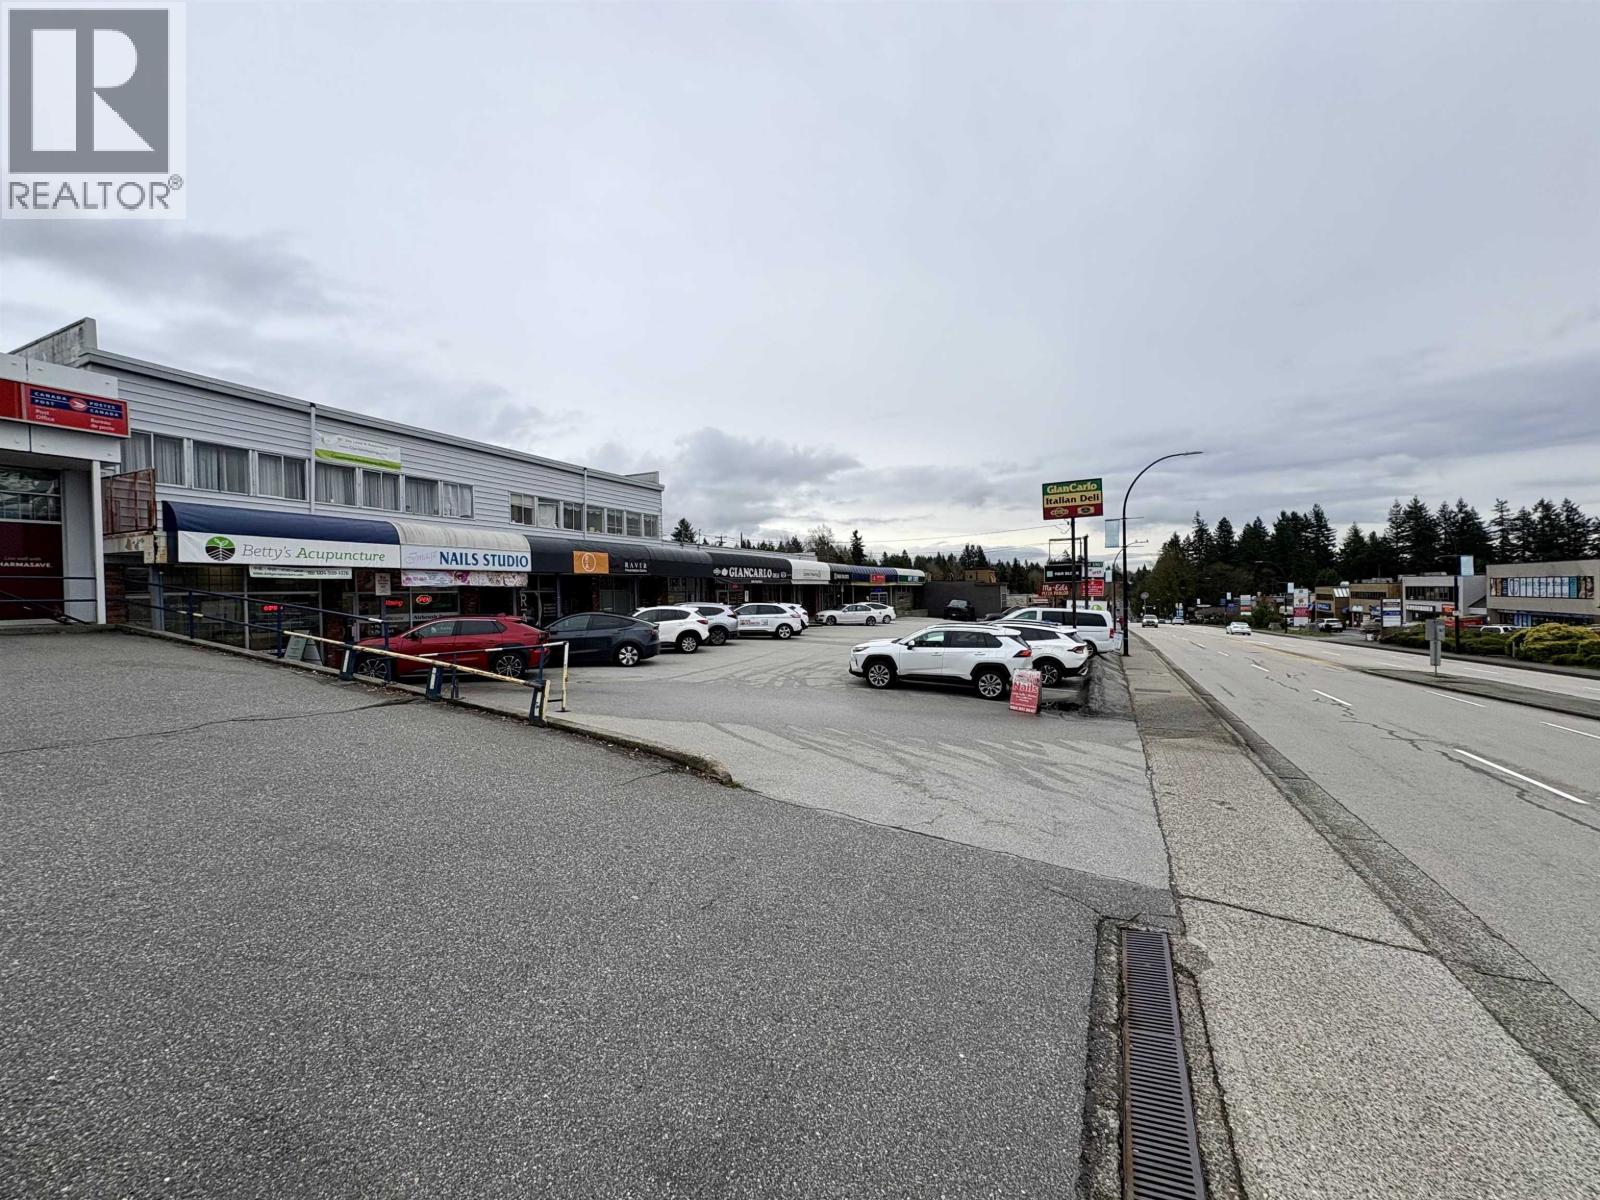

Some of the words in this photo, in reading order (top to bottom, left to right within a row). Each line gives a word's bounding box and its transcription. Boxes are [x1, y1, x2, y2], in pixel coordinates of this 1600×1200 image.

[33, 391, 68, 401] CANADA
[34, 399, 56, 407] POST
[89, 401, 116, 410] POSTES
[89, 408, 119, 417] CANADA
[35, 414, 55, 422] Office
[90, 418, 112, 426] Bureau
[98, 424, 115, 432] poste
[1045, 496, 1077, 506] Italian
[1079, 493, 1100, 502] Deli
[241, 543, 292, 559] Betty's
[295, 547, 386, 562] Acupuncture
[439, 551, 479, 566] NAILS
[482, 553, 529, 568] STUDIO
[728, 566, 773, 579] GIANCARLO
[1013, 682, 1039, 693] Nails
